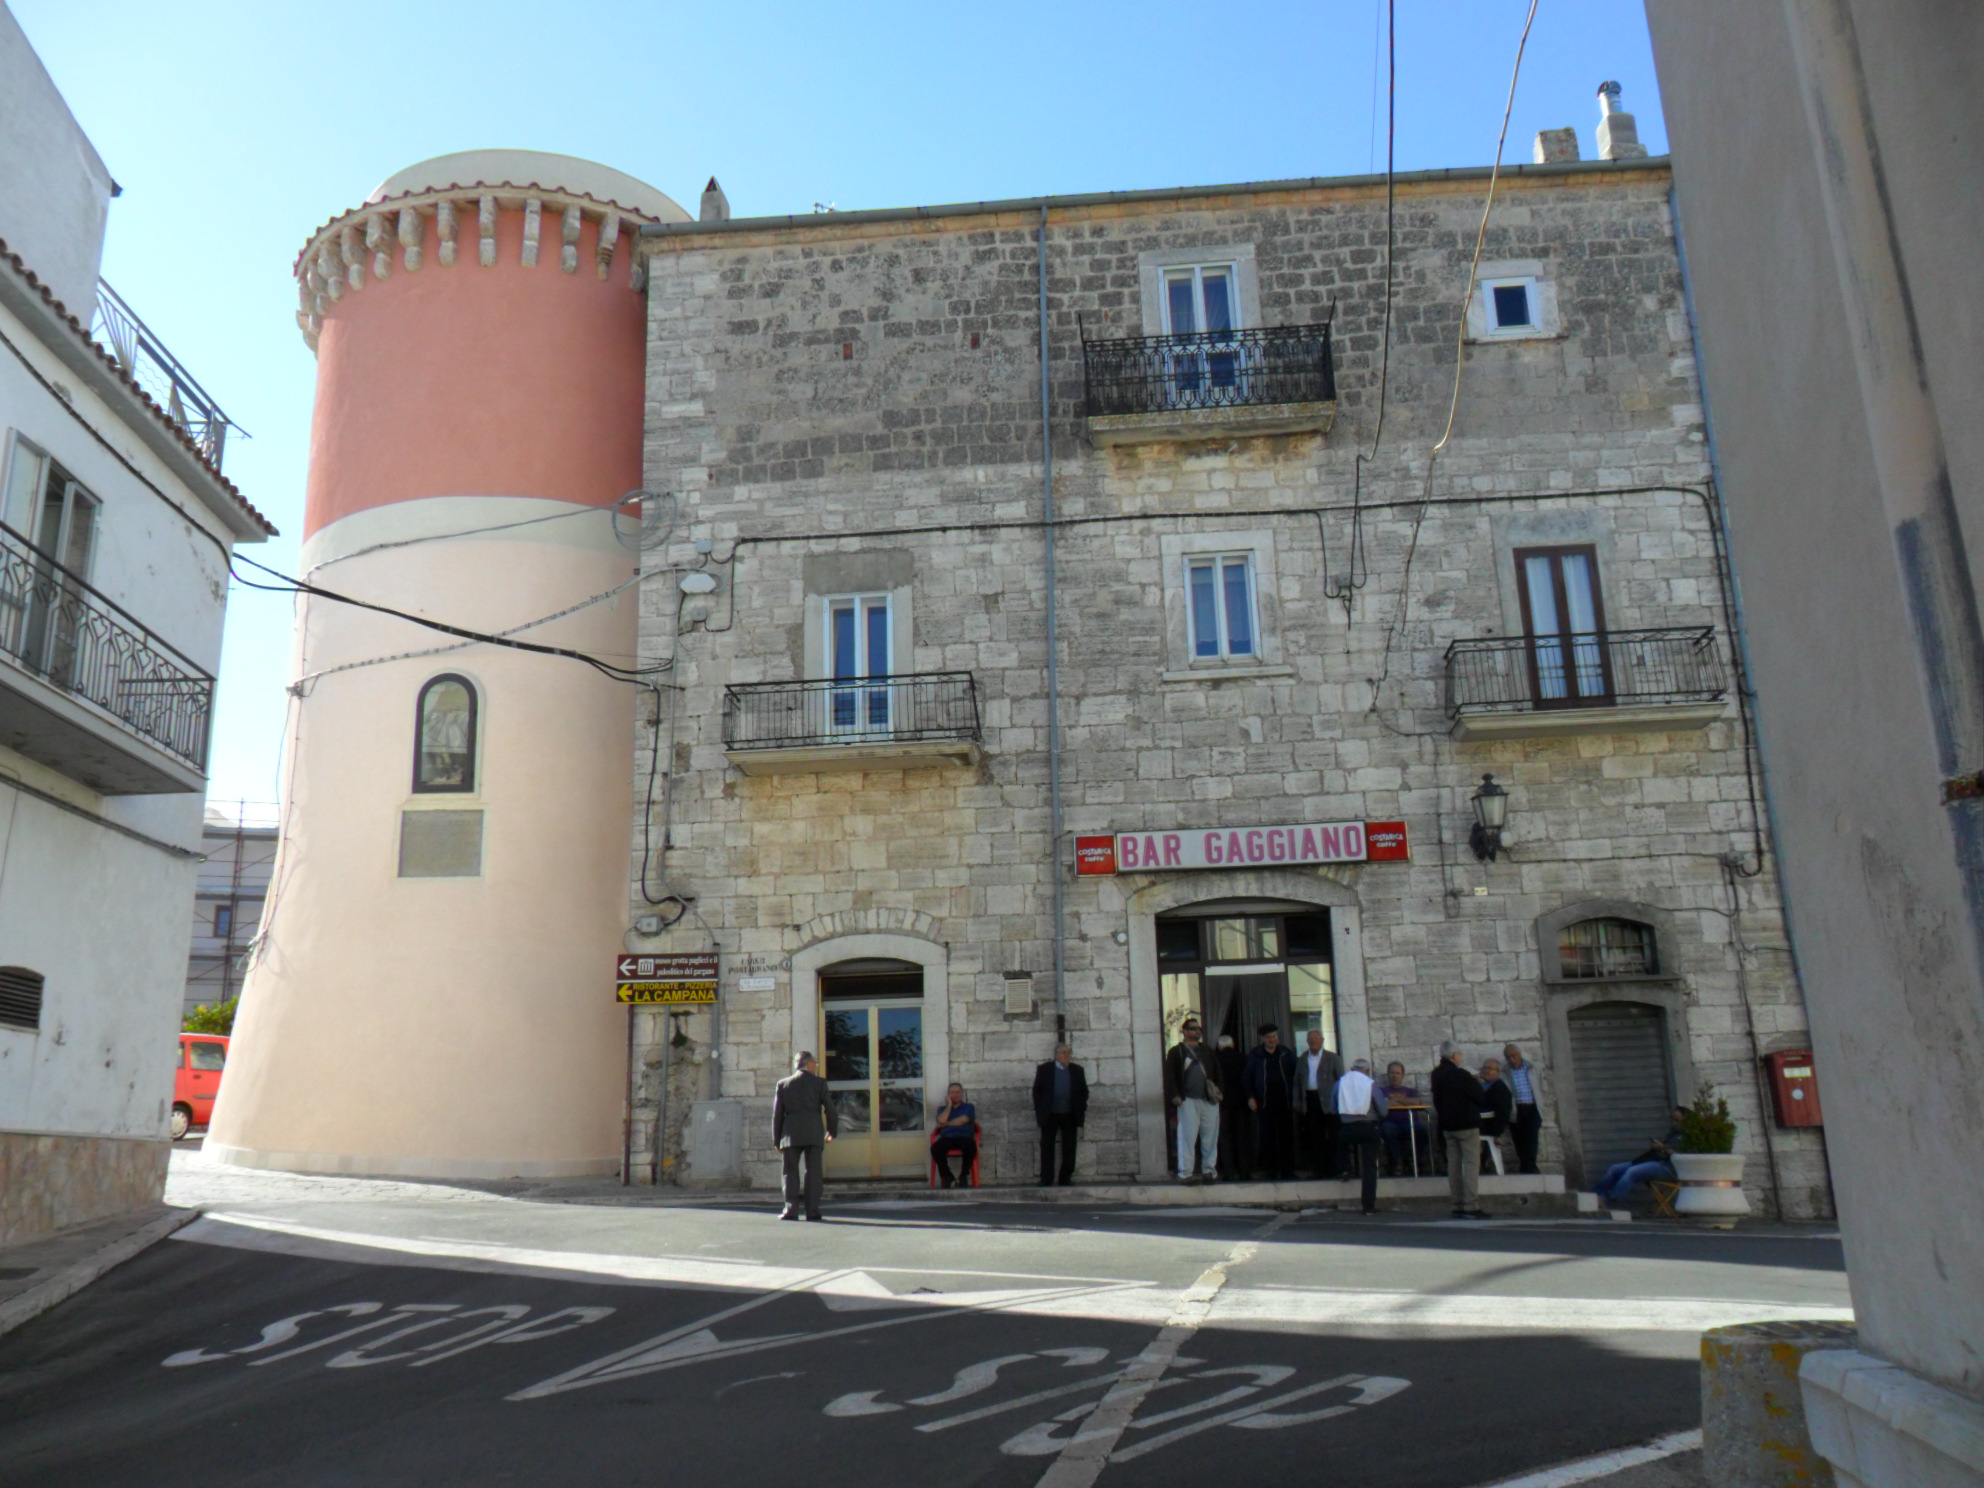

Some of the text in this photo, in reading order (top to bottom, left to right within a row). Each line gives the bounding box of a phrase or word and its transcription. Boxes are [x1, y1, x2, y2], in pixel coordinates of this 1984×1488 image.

[1120, 825, 1362, 868] BAR GAGGIANO
[672, 957, 688, 965] grotta
[684, 967, 693, 975] del
[694, 967, 715, 976] gargano
[633, 982, 679, 990] RISTORANTE
[685, 980, 717, 989] PIZZERIA
[634, 989, 716, 1002] LA CAMPANA
[161, 1301, 617, 1368] STOP
[823, 1346, 1412, 1462] STOP
